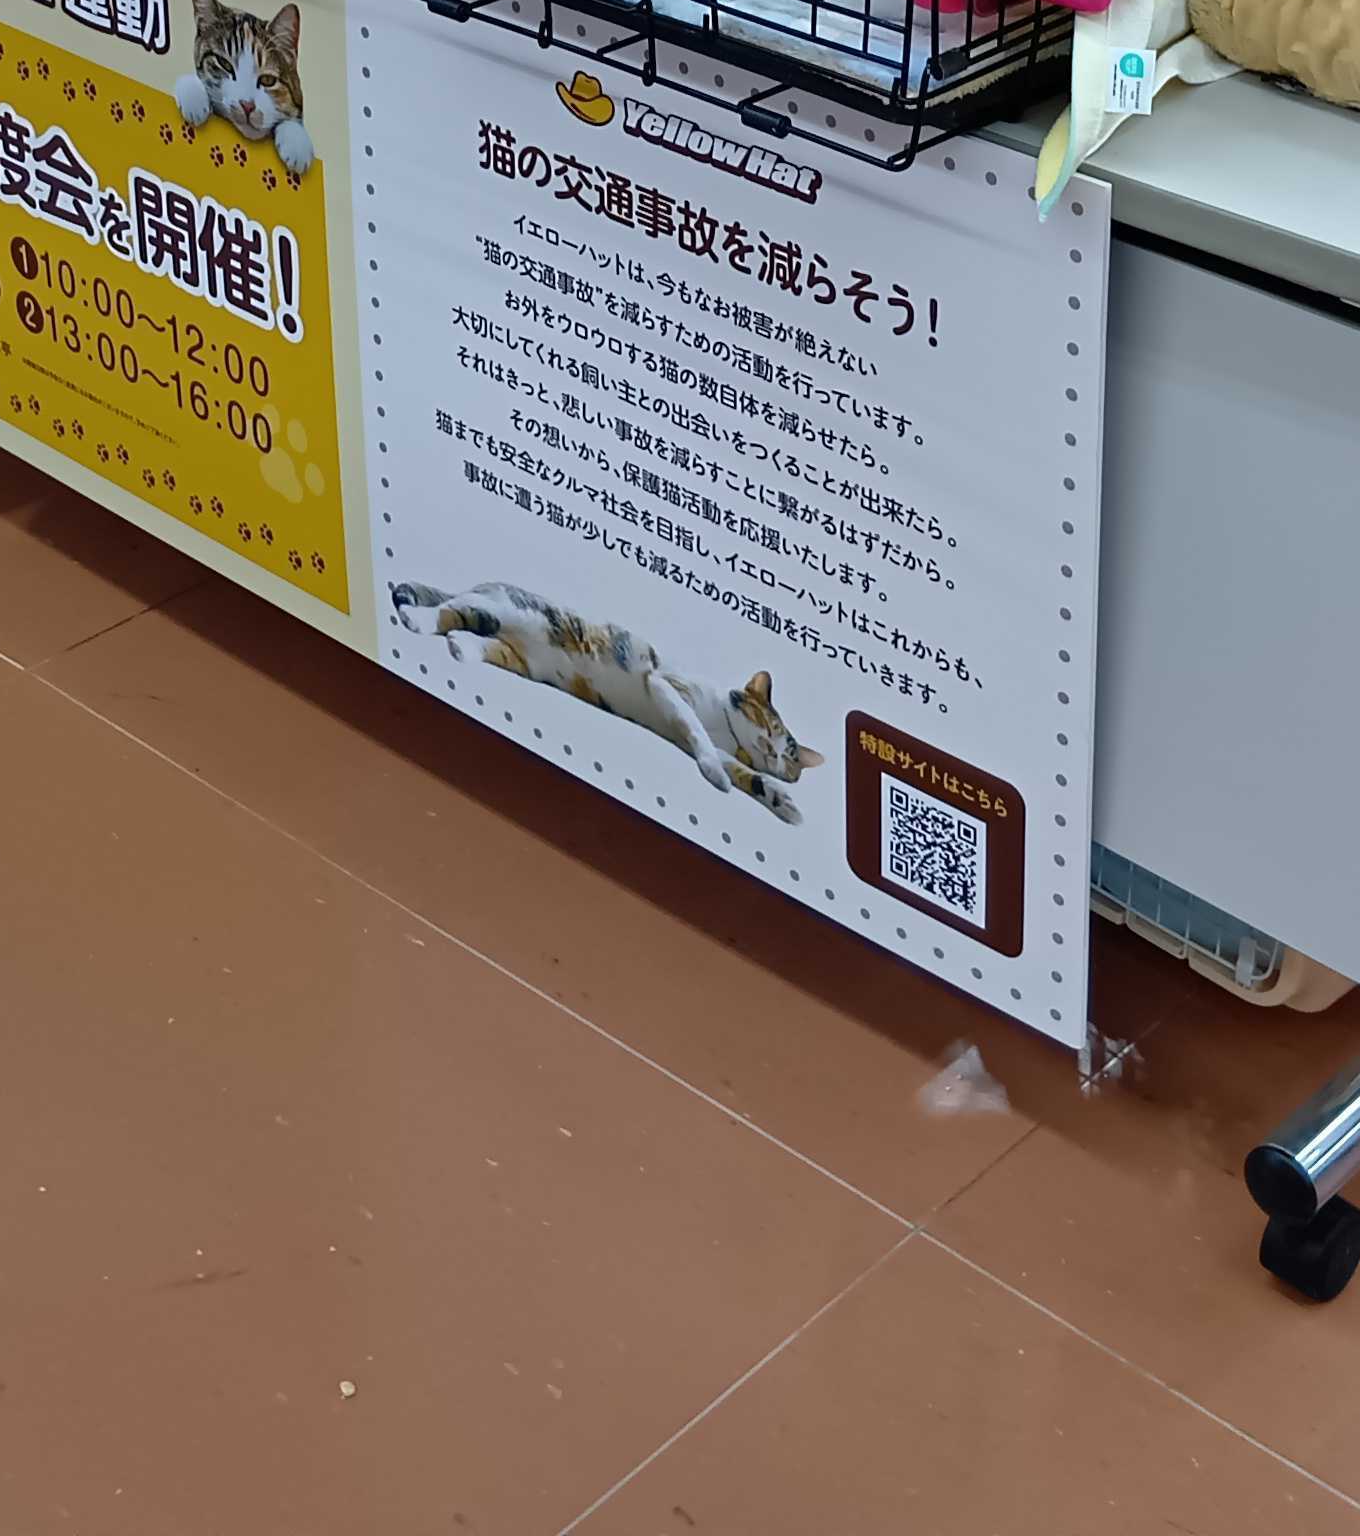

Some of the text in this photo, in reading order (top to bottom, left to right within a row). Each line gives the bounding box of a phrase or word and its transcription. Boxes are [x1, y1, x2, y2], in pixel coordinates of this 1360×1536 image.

[477, 120, 942, 348] 猫の交通事故を減らそう！
[621, 98, 822, 204] YellowHat
[504, 289, 890, 474] お外をウロウロする猫の数自体を減らせたら。
[513, 213, 880, 377] イエローハットは、今もなお被害が絶えない
[452, 305, 959, 549] 大切にしてくれる飼い主との出会いをつくることが出来たら。
[455, 346, 957, 589] それはきっと、悲しい事故を減らすことに繋がるはずだから。
[509, 409, 889, 602] その想いから、保護猫活動を応援いたします。
[435, 409, 984, 687] 猫までも安全なクルマ社会を目指し、イエローハットはこれからも、
[463, 462, 950, 714] 事故に遭う猫が少しでも減るための活動を行っていきます。
[858, 730, 1009, 819] 特設サイトはこちら
